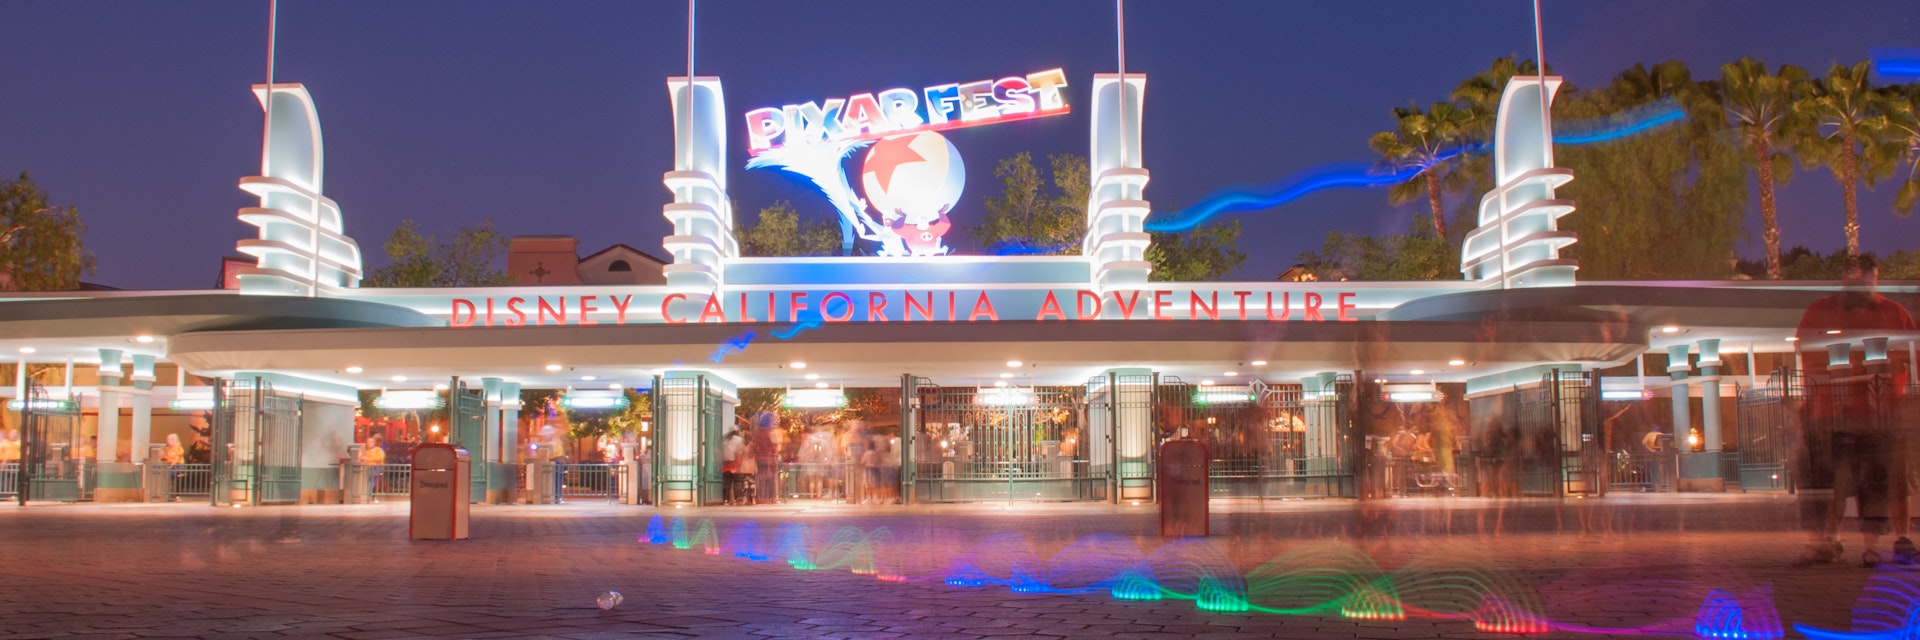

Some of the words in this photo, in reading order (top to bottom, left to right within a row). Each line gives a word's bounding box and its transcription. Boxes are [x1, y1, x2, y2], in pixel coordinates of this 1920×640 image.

[745, 88, 924, 150] PIXAR
[923, 68, 1068, 124] FEST
[450, 294, 633, 327] DISNEY
[660, 290, 999, 323] CALIFORNIA
[1035, 289, 1359, 322] ADVENTURE
